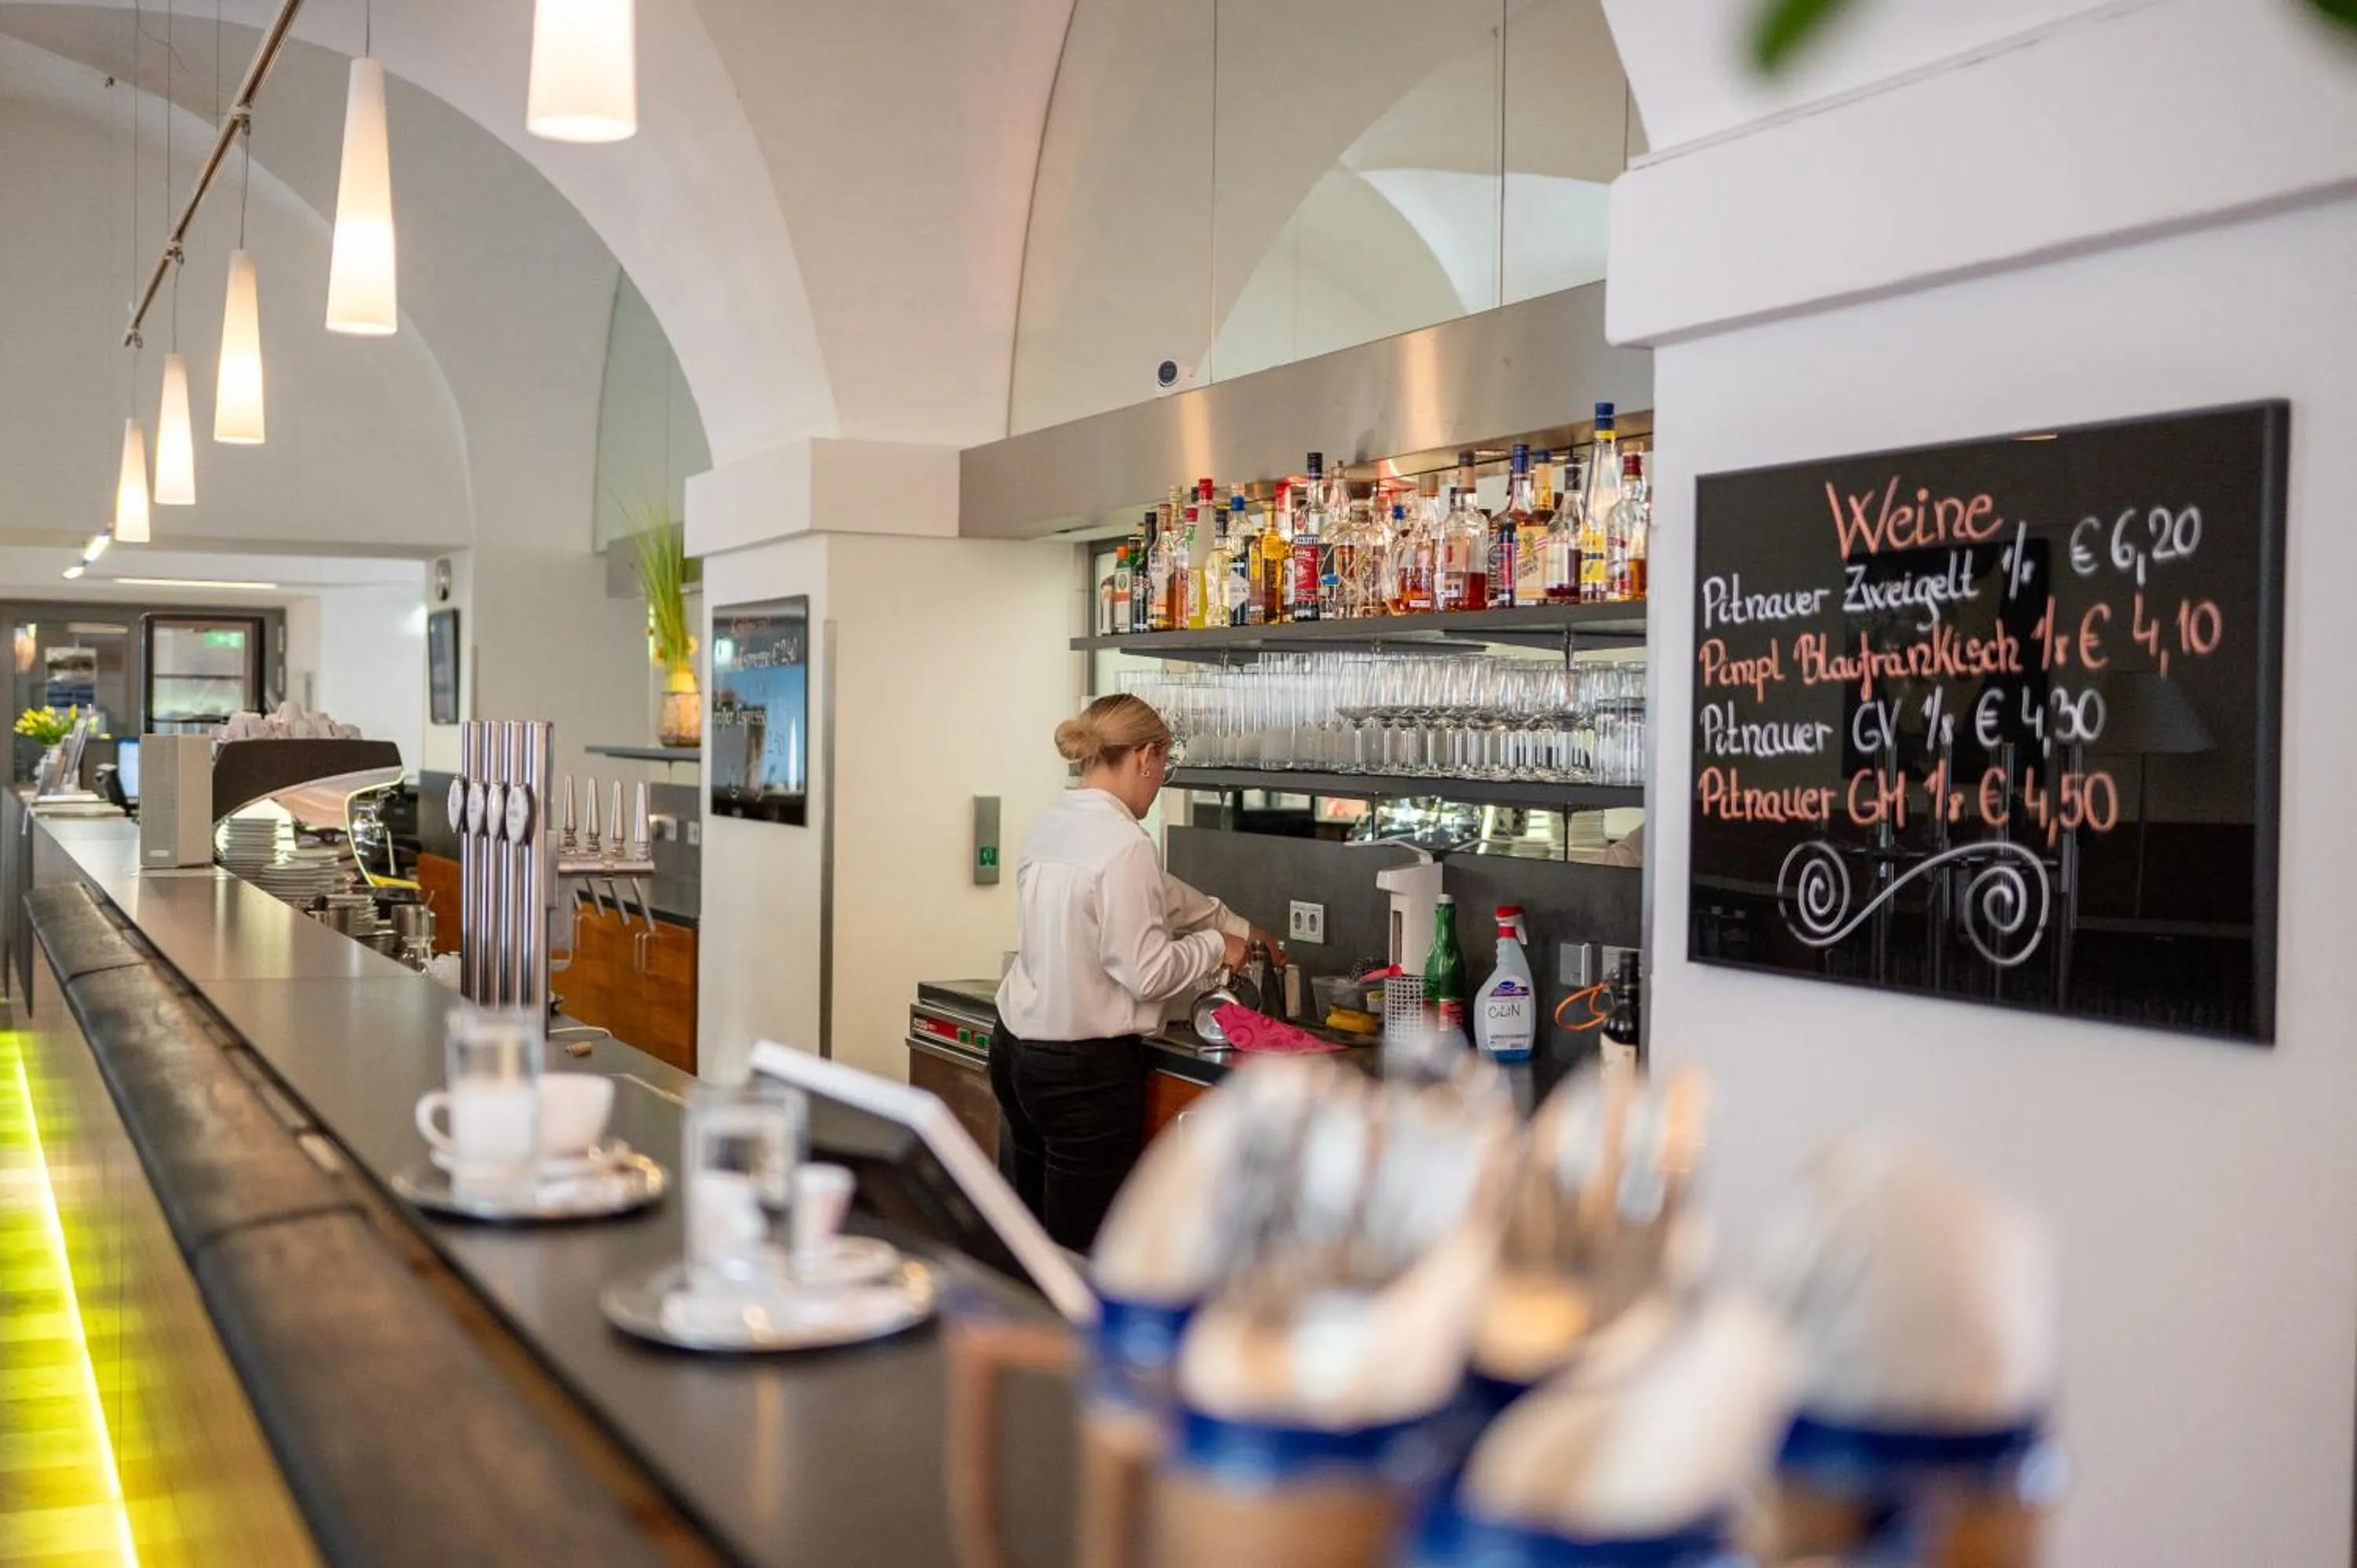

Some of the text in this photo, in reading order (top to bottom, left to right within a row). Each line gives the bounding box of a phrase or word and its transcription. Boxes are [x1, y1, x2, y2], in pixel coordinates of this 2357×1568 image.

[1825, 474, 2003, 560] Weine
[1702, 572, 1831, 631] Pitnauer
[1842, 548, 1980, 632] Zweigelt
[2110, 506, 2203, 587] 6,20
[1698, 636, 1784, 703] Pimpl
[2132, 591, 2223, 681] 4,10
[1699, 699, 1834, 757] Pitnauer
[1851, 697, 1903, 753] GV
[1974, 688, 2005, 747] €
[2021, 684, 2106, 759] 4,30
[1697, 766, 1839, 823] Pitnauer
[1978, 766, 2011, 826] €
[2024, 765, 2120, 849] 4,50
